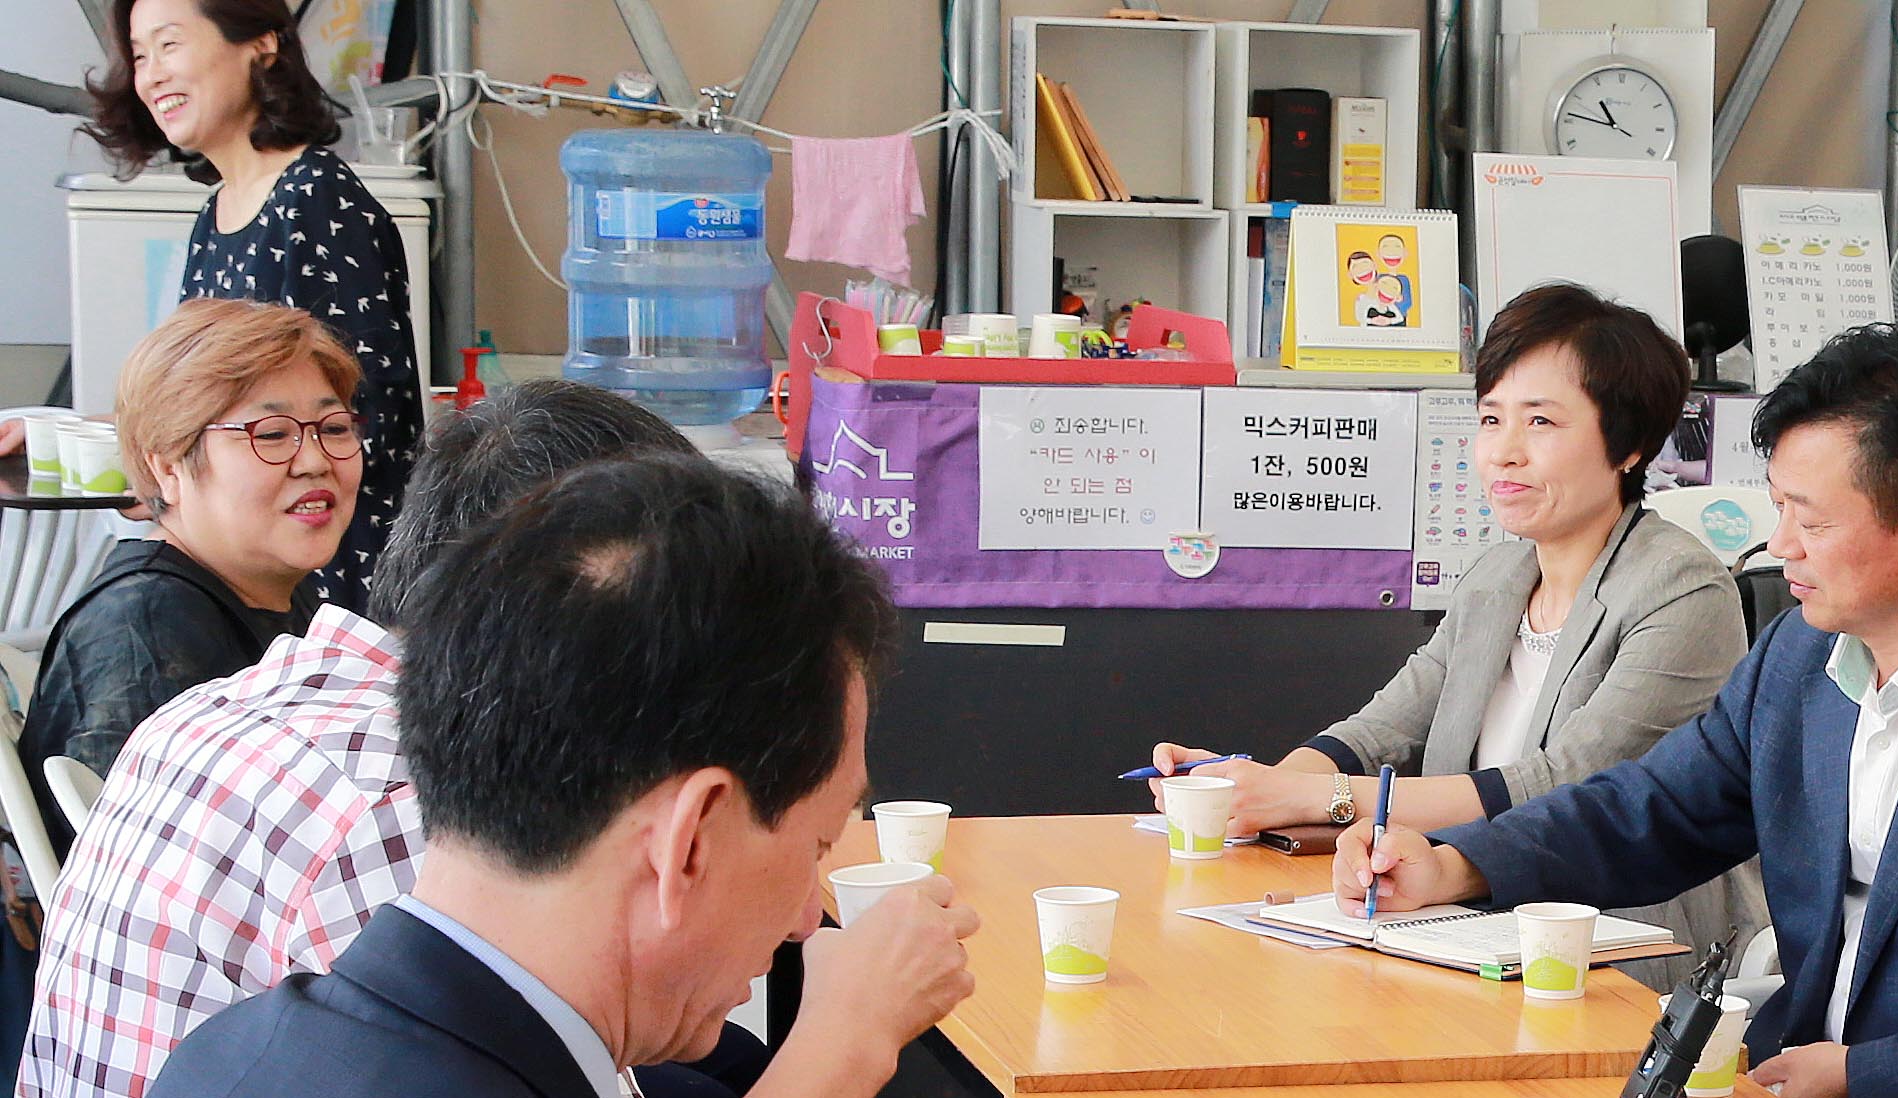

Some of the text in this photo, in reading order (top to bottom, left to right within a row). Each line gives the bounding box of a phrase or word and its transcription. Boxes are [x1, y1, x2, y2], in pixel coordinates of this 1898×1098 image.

[1054, 417, 1148, 434] 죄송합니다.
[1244, 415, 1377, 440] 믹스커피판매
[1139, 448, 1155, 464] 이
[1251, 454, 1369, 478] 1잔, 500원
[1044, 478, 1132, 494] 안 되는 점
[1234, 492, 1382, 511] 많은이용바랍니다.
[1020, 508, 1130, 524] 양해바랍니다.
